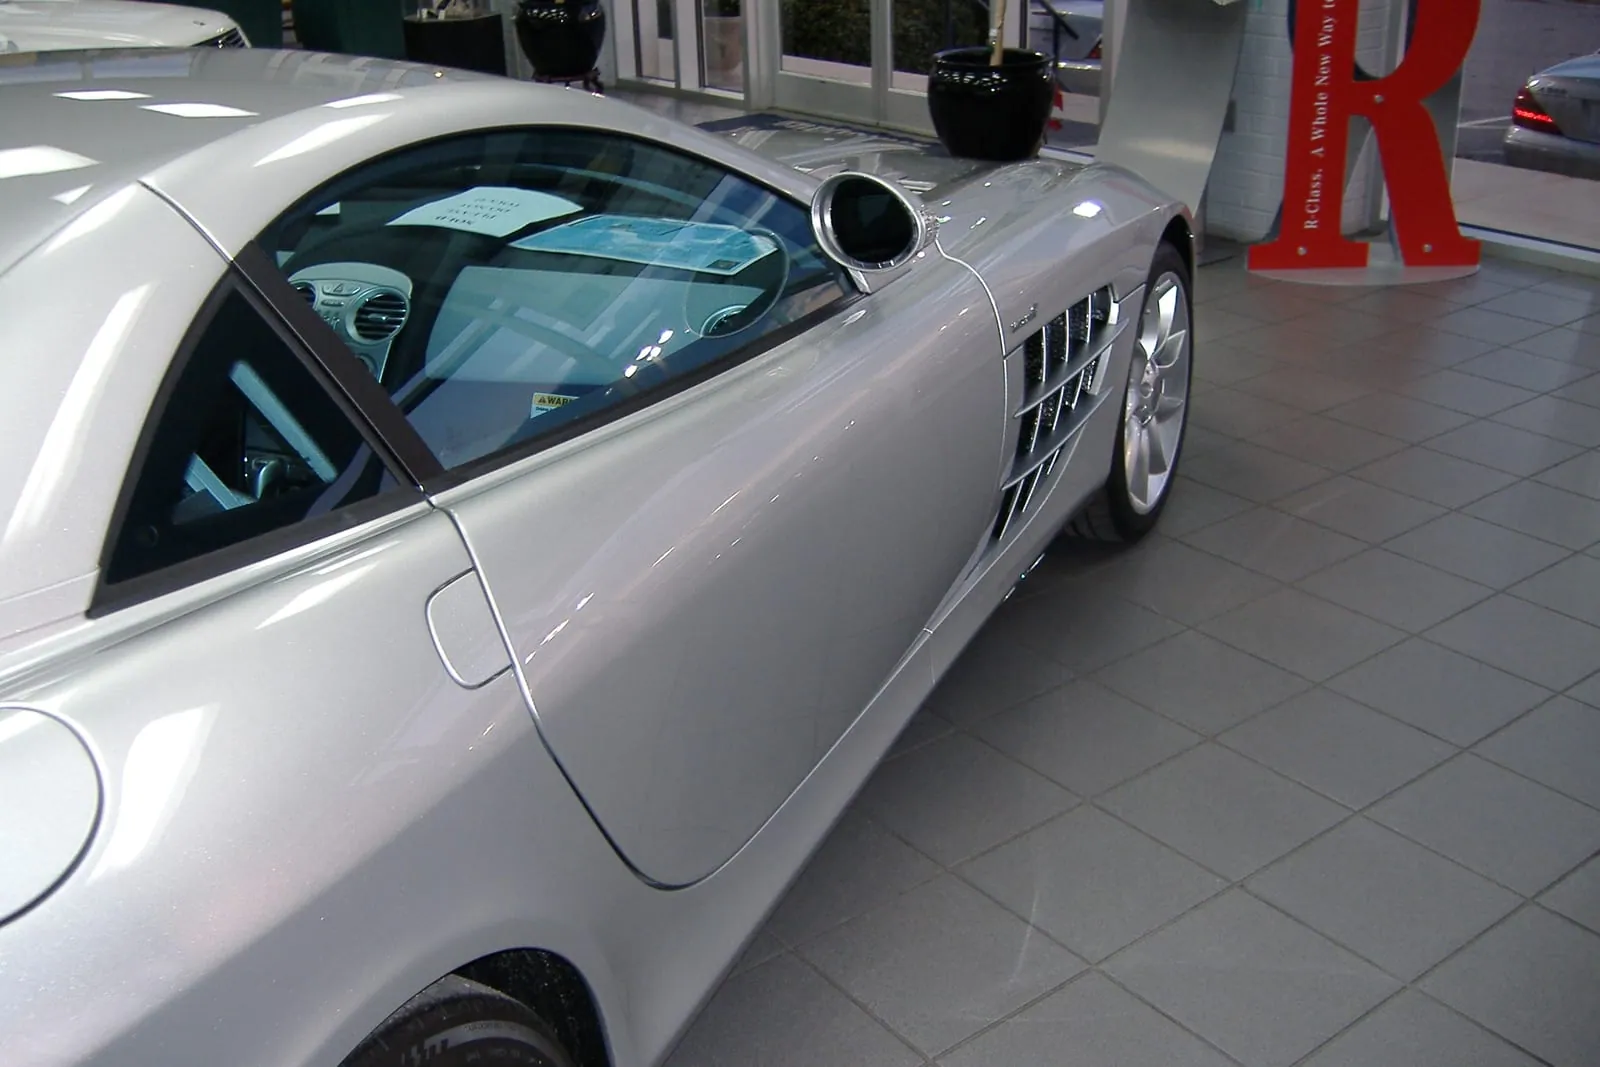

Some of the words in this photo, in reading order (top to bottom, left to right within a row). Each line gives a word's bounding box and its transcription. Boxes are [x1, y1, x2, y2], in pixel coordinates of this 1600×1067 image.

[1317, 17, 1337, 47] Way
[1314, 54, 1332, 87] New
[1310, 92, 1329, 141] Whole
[1310, 146, 1325, 158] A
[1303, 168, 1323, 229] R-Class.
